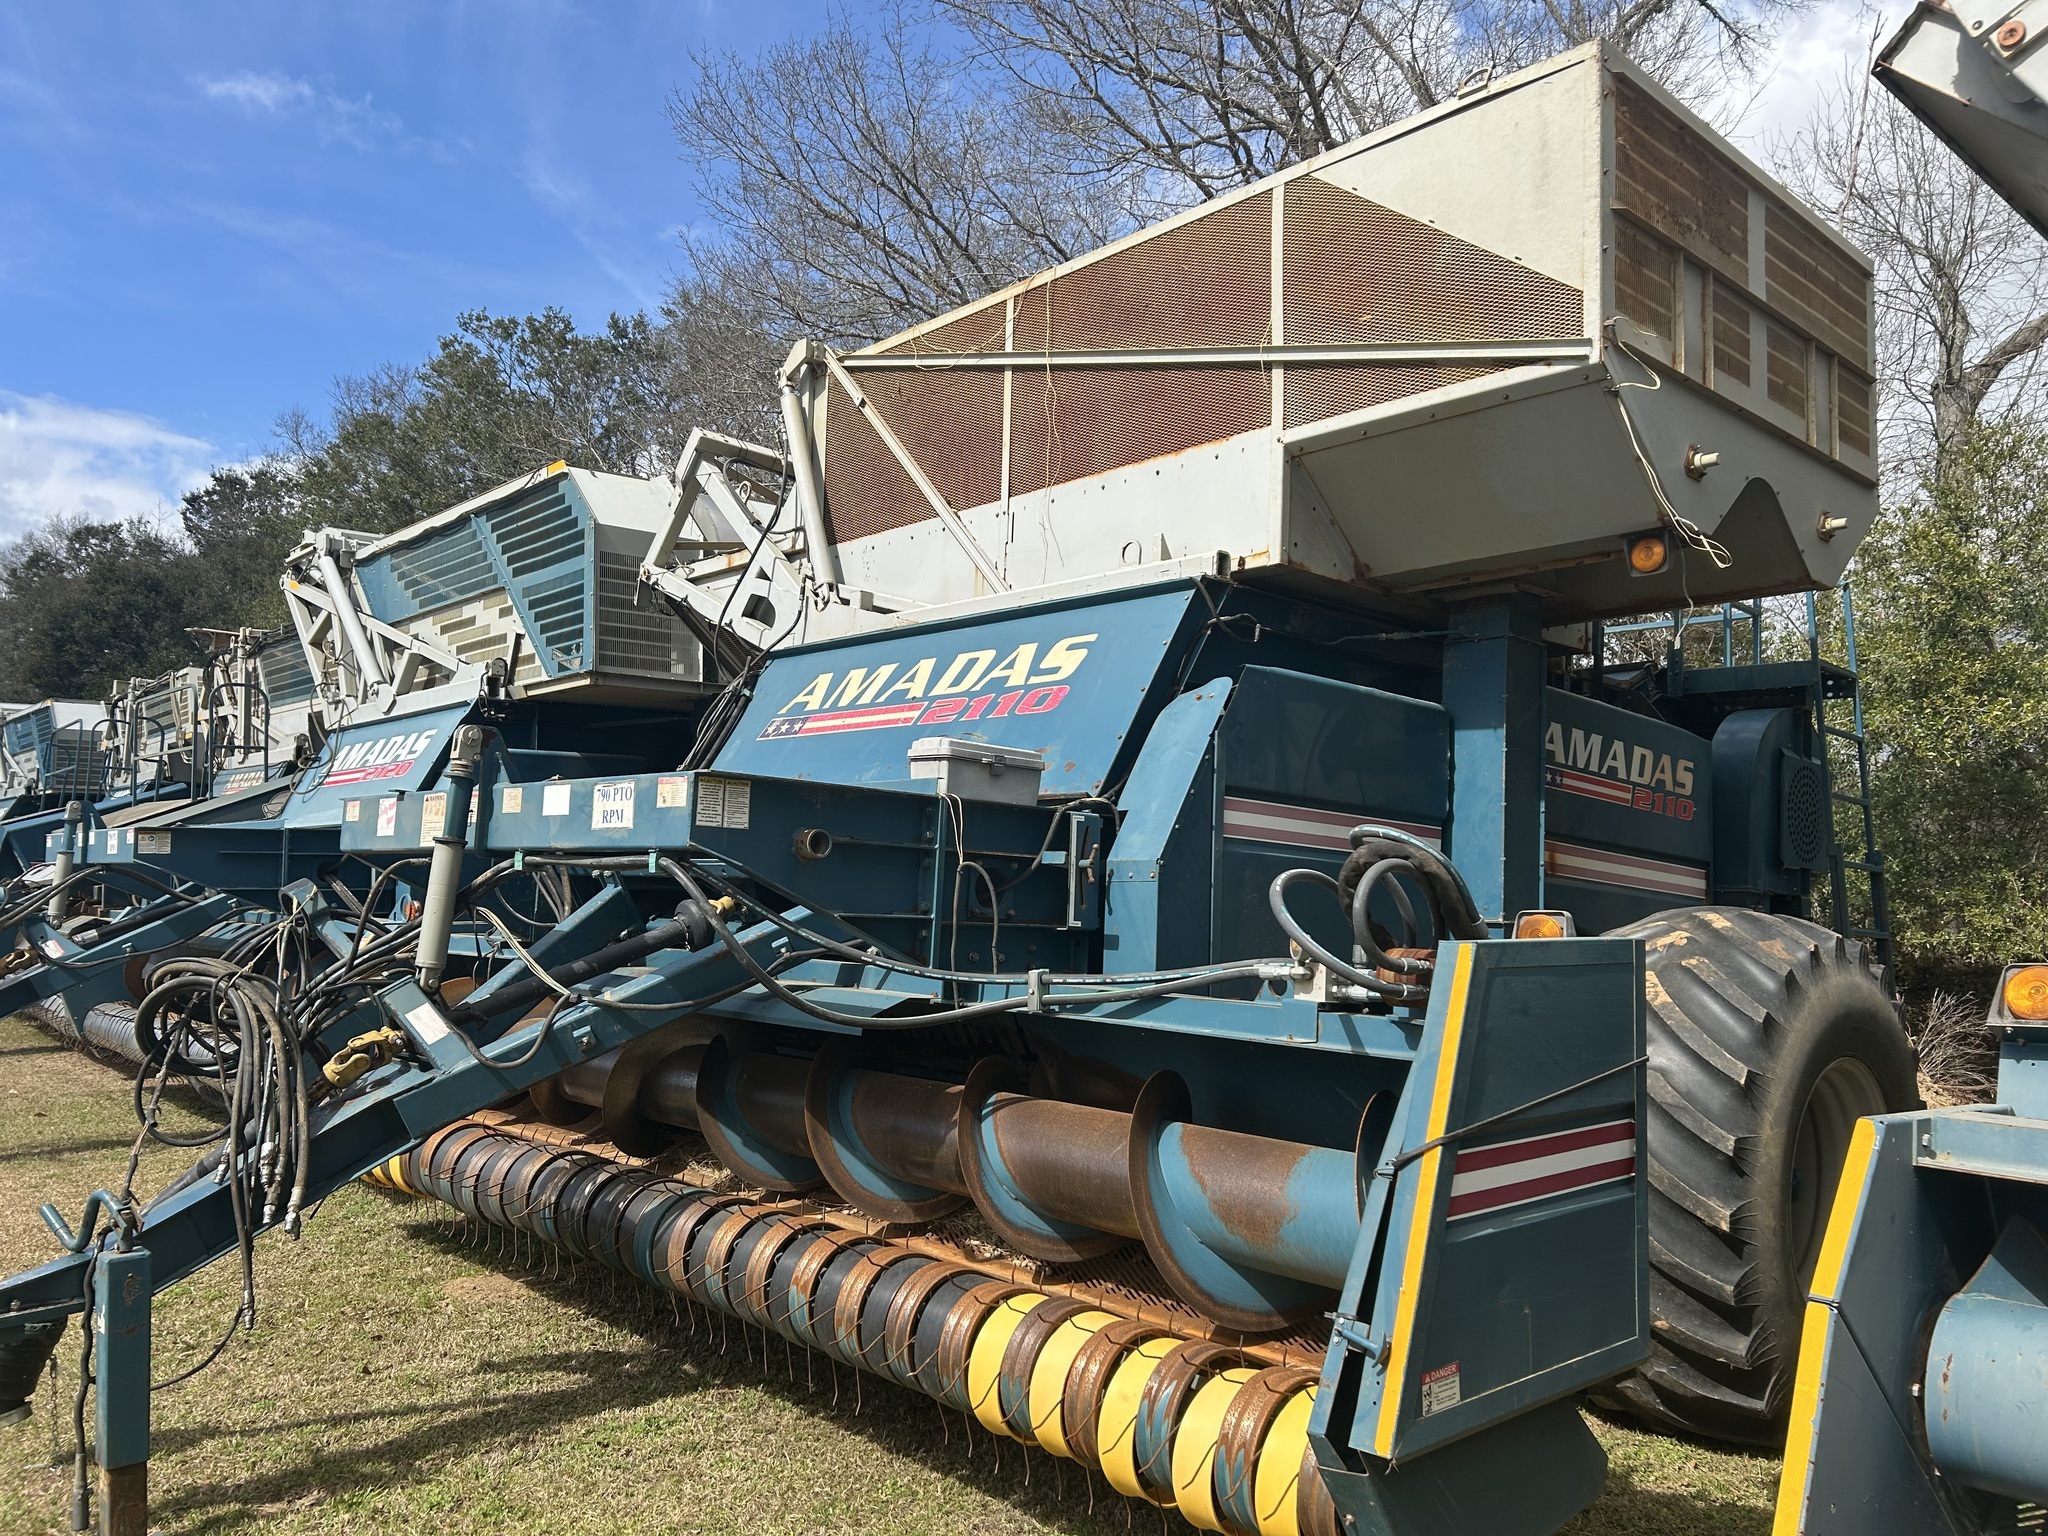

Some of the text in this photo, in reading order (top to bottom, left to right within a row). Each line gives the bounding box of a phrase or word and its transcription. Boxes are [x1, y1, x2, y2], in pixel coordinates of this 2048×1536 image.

[777, 633, 1099, 714] AMADAS
[917, 685, 1070, 725] 2110
[321, 729, 438, 773] AMADAS
[1545, 722, 1694, 796] AMADAS
[360, 760, 414, 780] 2120
[613, 786, 633, 802] PTO
[1632, 788, 1694, 820] 2110
[602, 809, 624, 824] RPM
[1431, 1364, 1457, 1380] DANGER
